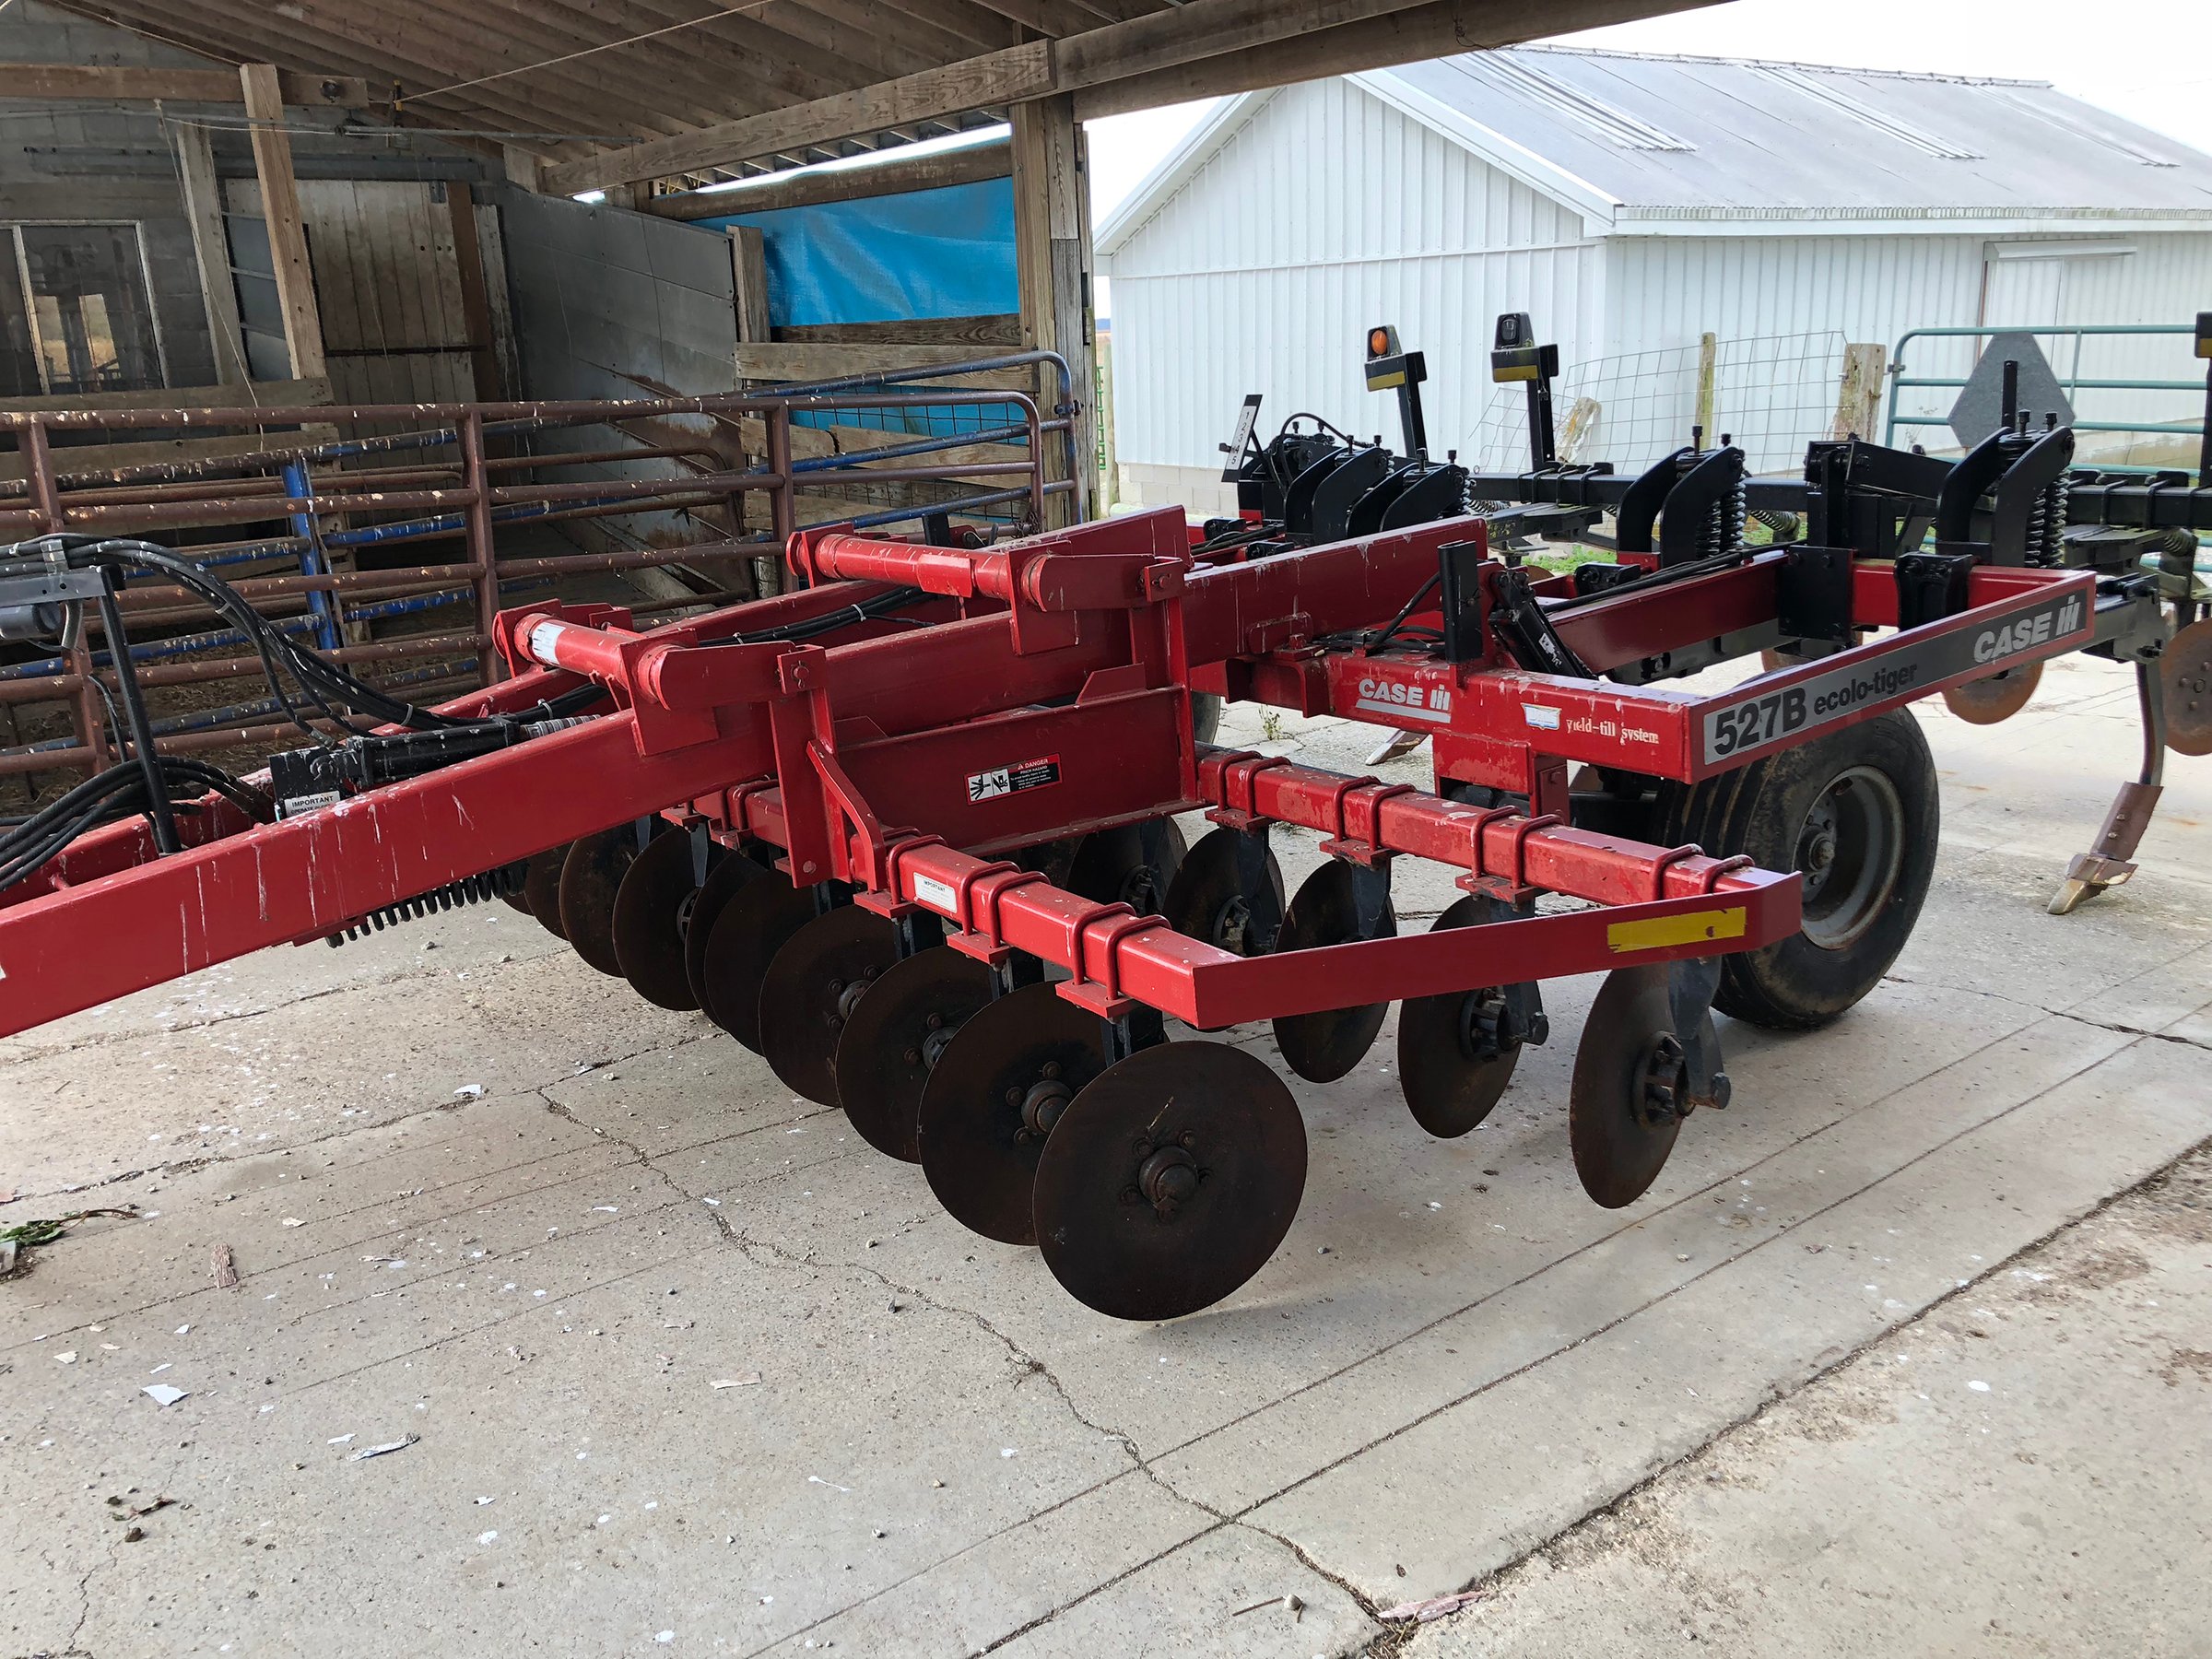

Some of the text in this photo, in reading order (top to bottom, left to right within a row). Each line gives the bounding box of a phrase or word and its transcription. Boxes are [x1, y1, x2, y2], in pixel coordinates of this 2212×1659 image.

[1241, 422, 1247, 431] 2
[1238, 433, 1244, 442] 3
[1231, 455, 1237, 465] 5
[1973, 611, 2053, 663] CASE
[1359, 677, 1424, 706] CASE
[1714, 664, 1917, 756] 527B ecolo-tiger
[1025, 759, 1048, 768] DANGER
[291, 795, 334, 807] IMPORTANT
